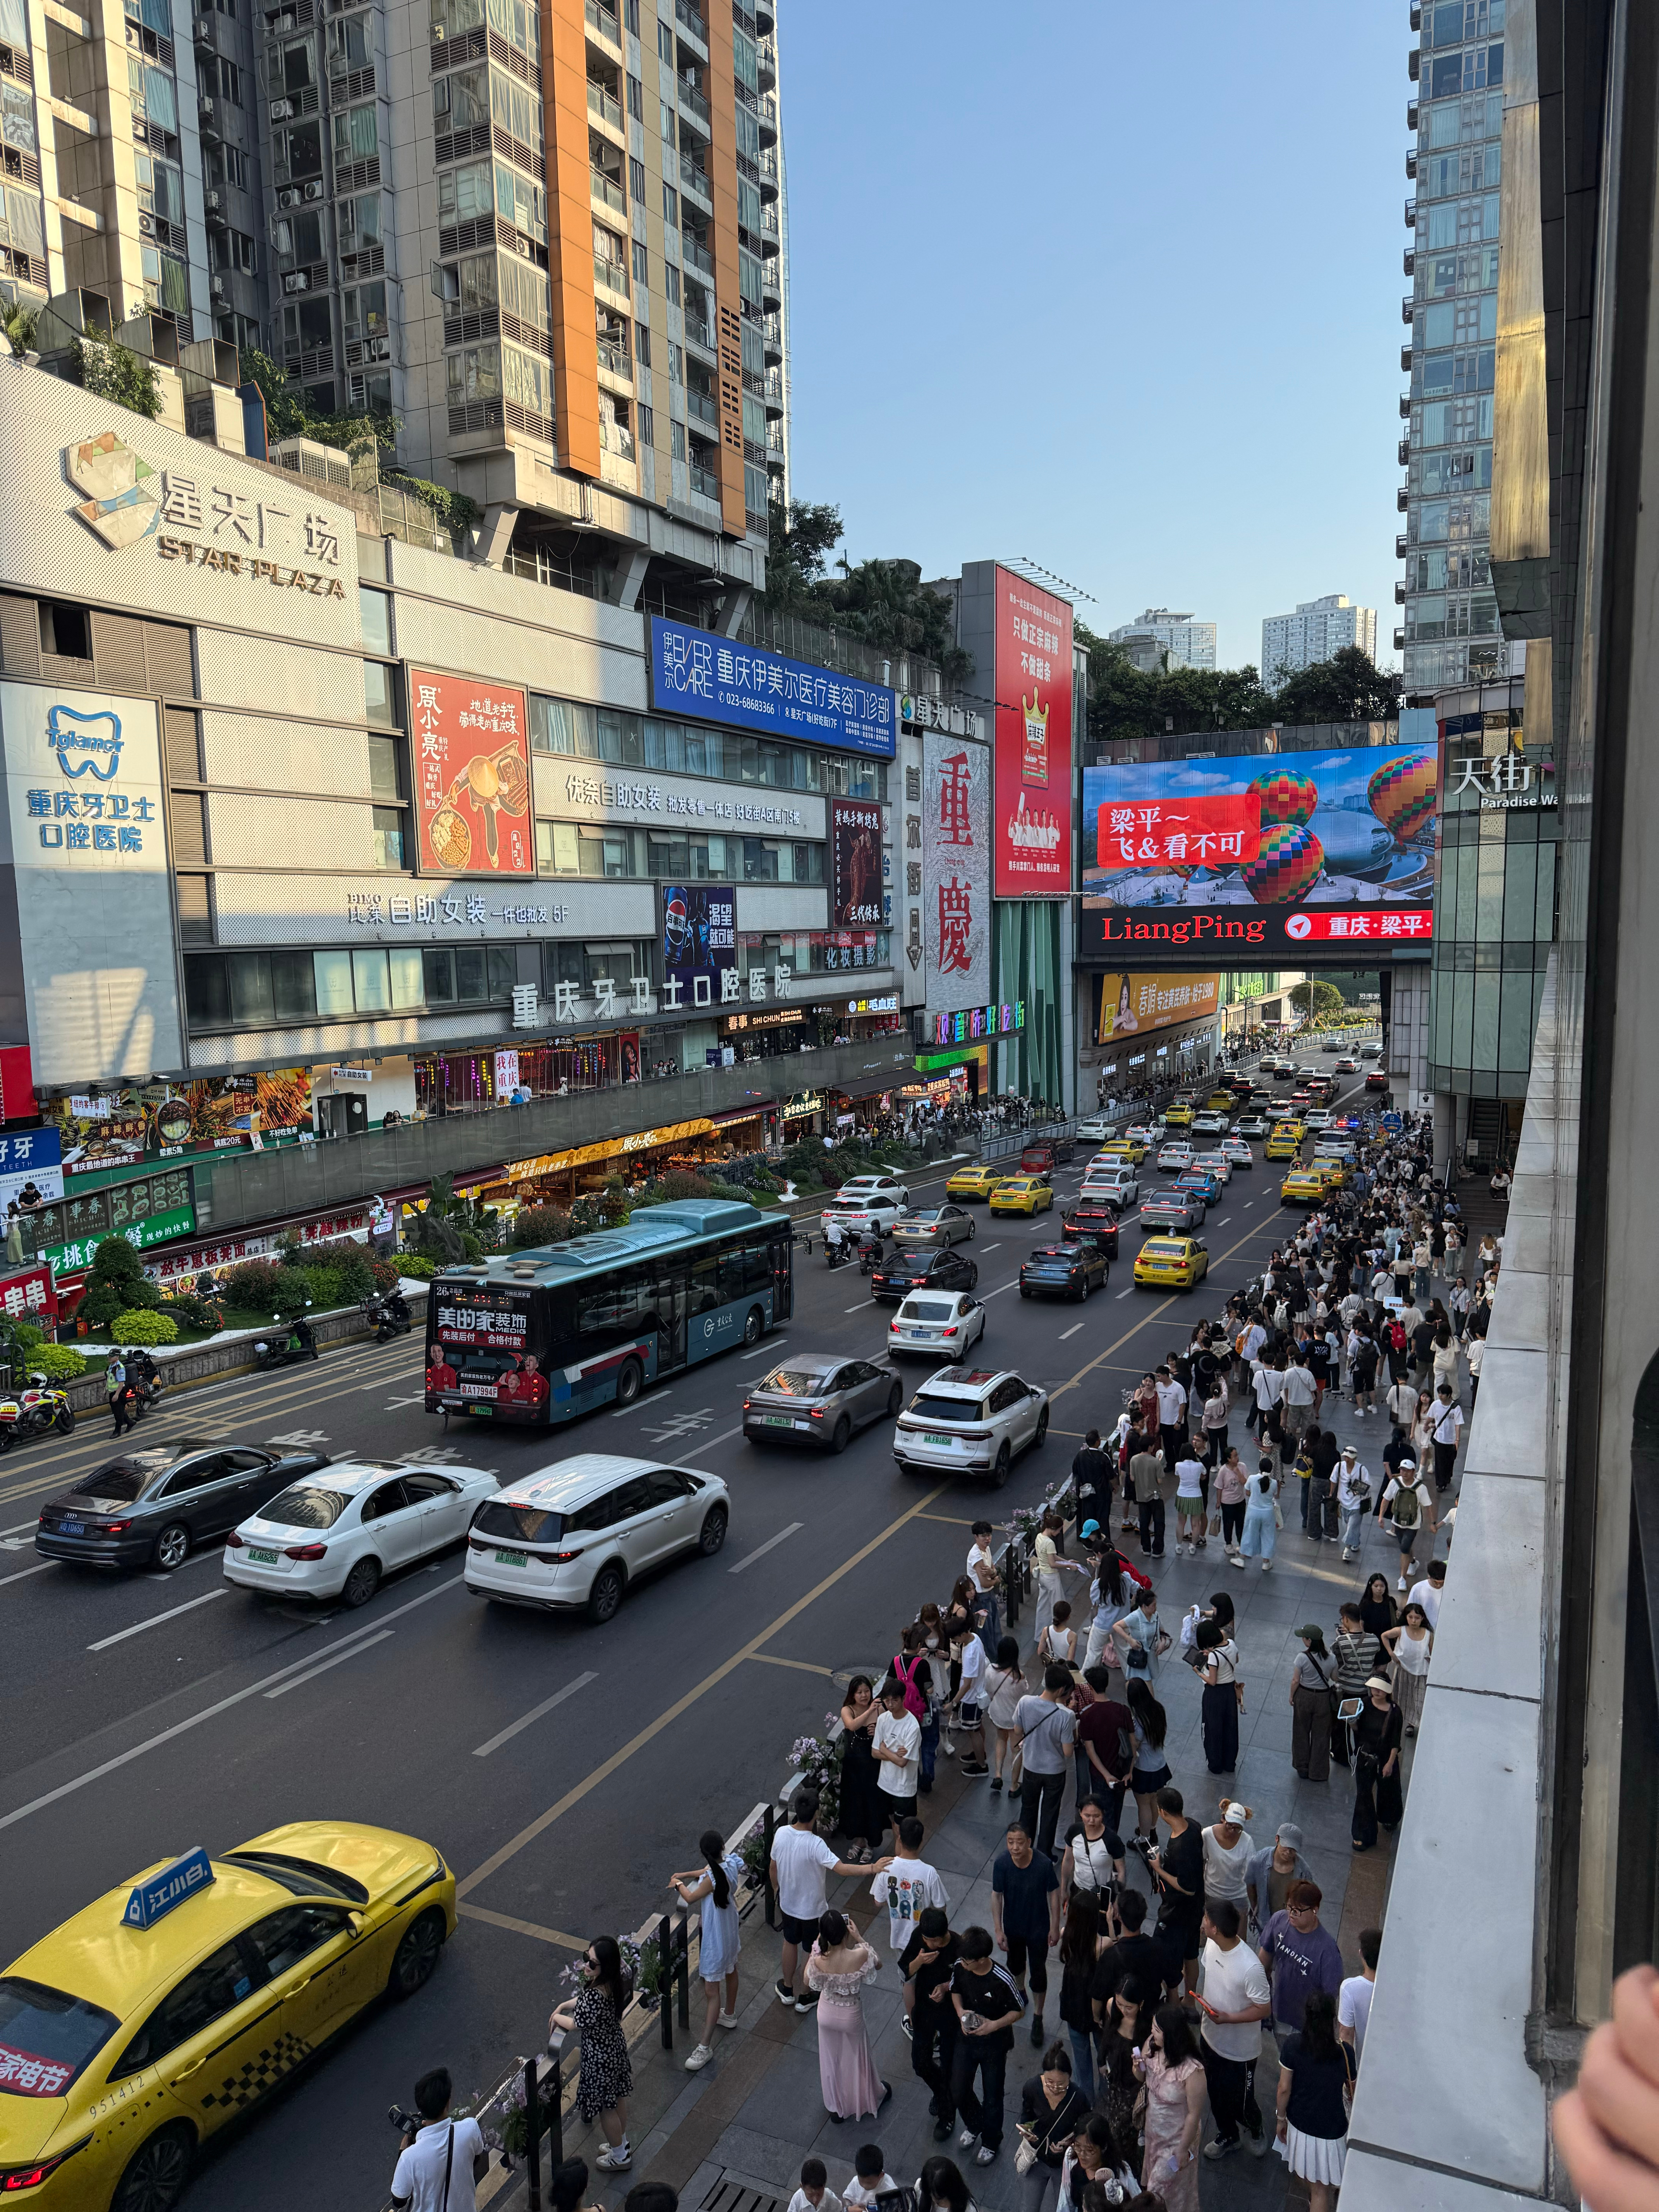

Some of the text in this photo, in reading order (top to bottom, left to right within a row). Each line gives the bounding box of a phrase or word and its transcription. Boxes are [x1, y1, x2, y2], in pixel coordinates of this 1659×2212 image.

[164, 469, 342, 565] 星天广场
[160, 535, 346, 599] STAR PLAZA
[1013, 616, 1058, 656] 只做正宗麻辣
[663, 632, 673, 689] 伊美尔
[673, 635, 712, 672] EVER
[1021, 651, 1051, 682] 不做甜条
[674, 663, 713, 699] CARE
[717, 648, 889, 723] 重庆伊美尔医疗美容门诊部
[726, 692, 774, 714] 023-68683366
[917, 696, 976, 737] 星天广场
[417, 685, 442, 761] 周小亮
[1450, 754, 1533, 796] 天街
[27, 789, 155, 822] 重庆牙卫士
[566, 775, 800, 825] 优奈自助女装 批发零售一体店 好吃街A区南门5楼
[1481, 796, 1537, 809] Paradise
[41, 822, 143, 852] 口腔医院
[348, 894, 382, 904] BIMO
[390, 893, 569, 924] 自助女装 一件也批发 5F
[850, 903, 880, 922] 三代传承
[709, 903, 732, 926] 渴望
[709, 929, 734, 945] 就可能
[1101, 914, 1266, 944] LiangPing
[826, 945, 876, 968] 化妆摄影
[512, 963, 792, 1028] 重庆牙卫士口腔医院
[868, 996, 896, 1011] 毛血旺
[1139, 983, 1156, 1016] 春娟
[763, 1014, 780, 1023] CHUN
[935, 1001, 1024, 1045] 观音桥好吃街
[497, 1054, 516, 1070] 我在
[498, 1071, 517, 1087] 重庆
[101, 1120, 146, 1139] 麻辣鲜香
[214, 1136, 241, 1147] 锅底20元
[269, 1126, 298, 1137] 不好吃免单
[620, 1132, 653, 1152] 周小亮
[71, 1154, 136, 1173] 重庆最地道的串串王
[160, 1146, 183, 1157] 荤素5角
[3, 1161, 32, 1170] TEETH
[146, 1221, 189, 1242] 现炒的快餐
[438, 1307, 526, 1332] 美的家装饰
[443, 1331, 521, 1346] 先装后付 合格付款
[0, 2049, 70, 2092] 家电节
[89, 2075, 144, 2120] 951412
